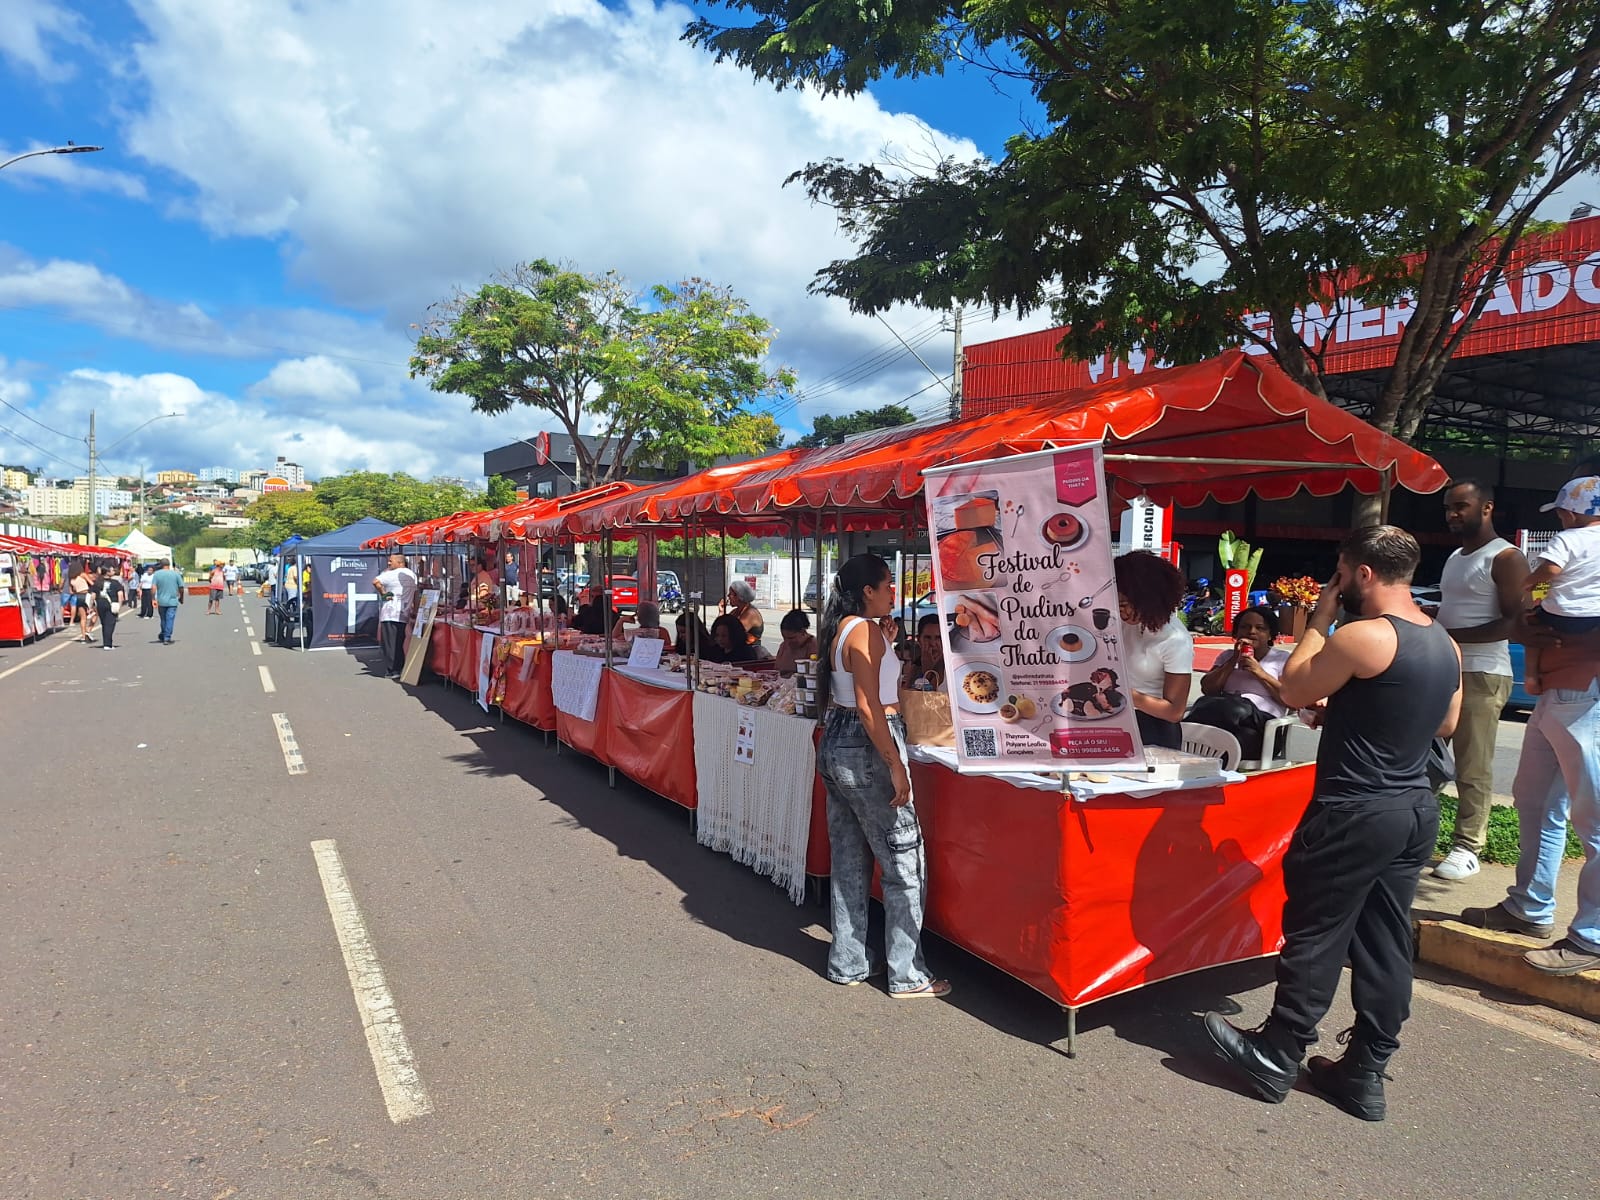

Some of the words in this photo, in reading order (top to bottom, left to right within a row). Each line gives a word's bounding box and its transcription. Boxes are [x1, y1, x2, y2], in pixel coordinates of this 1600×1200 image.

[1143, 503, 1155, 549] ERCAD
[978, 544, 1064, 580] Festival
[1012, 573, 1034, 593] de
[1000, 595, 1077, 621] Pudins
[1014, 620, 1040, 641] da
[1000, 644, 1061, 667] Thata
